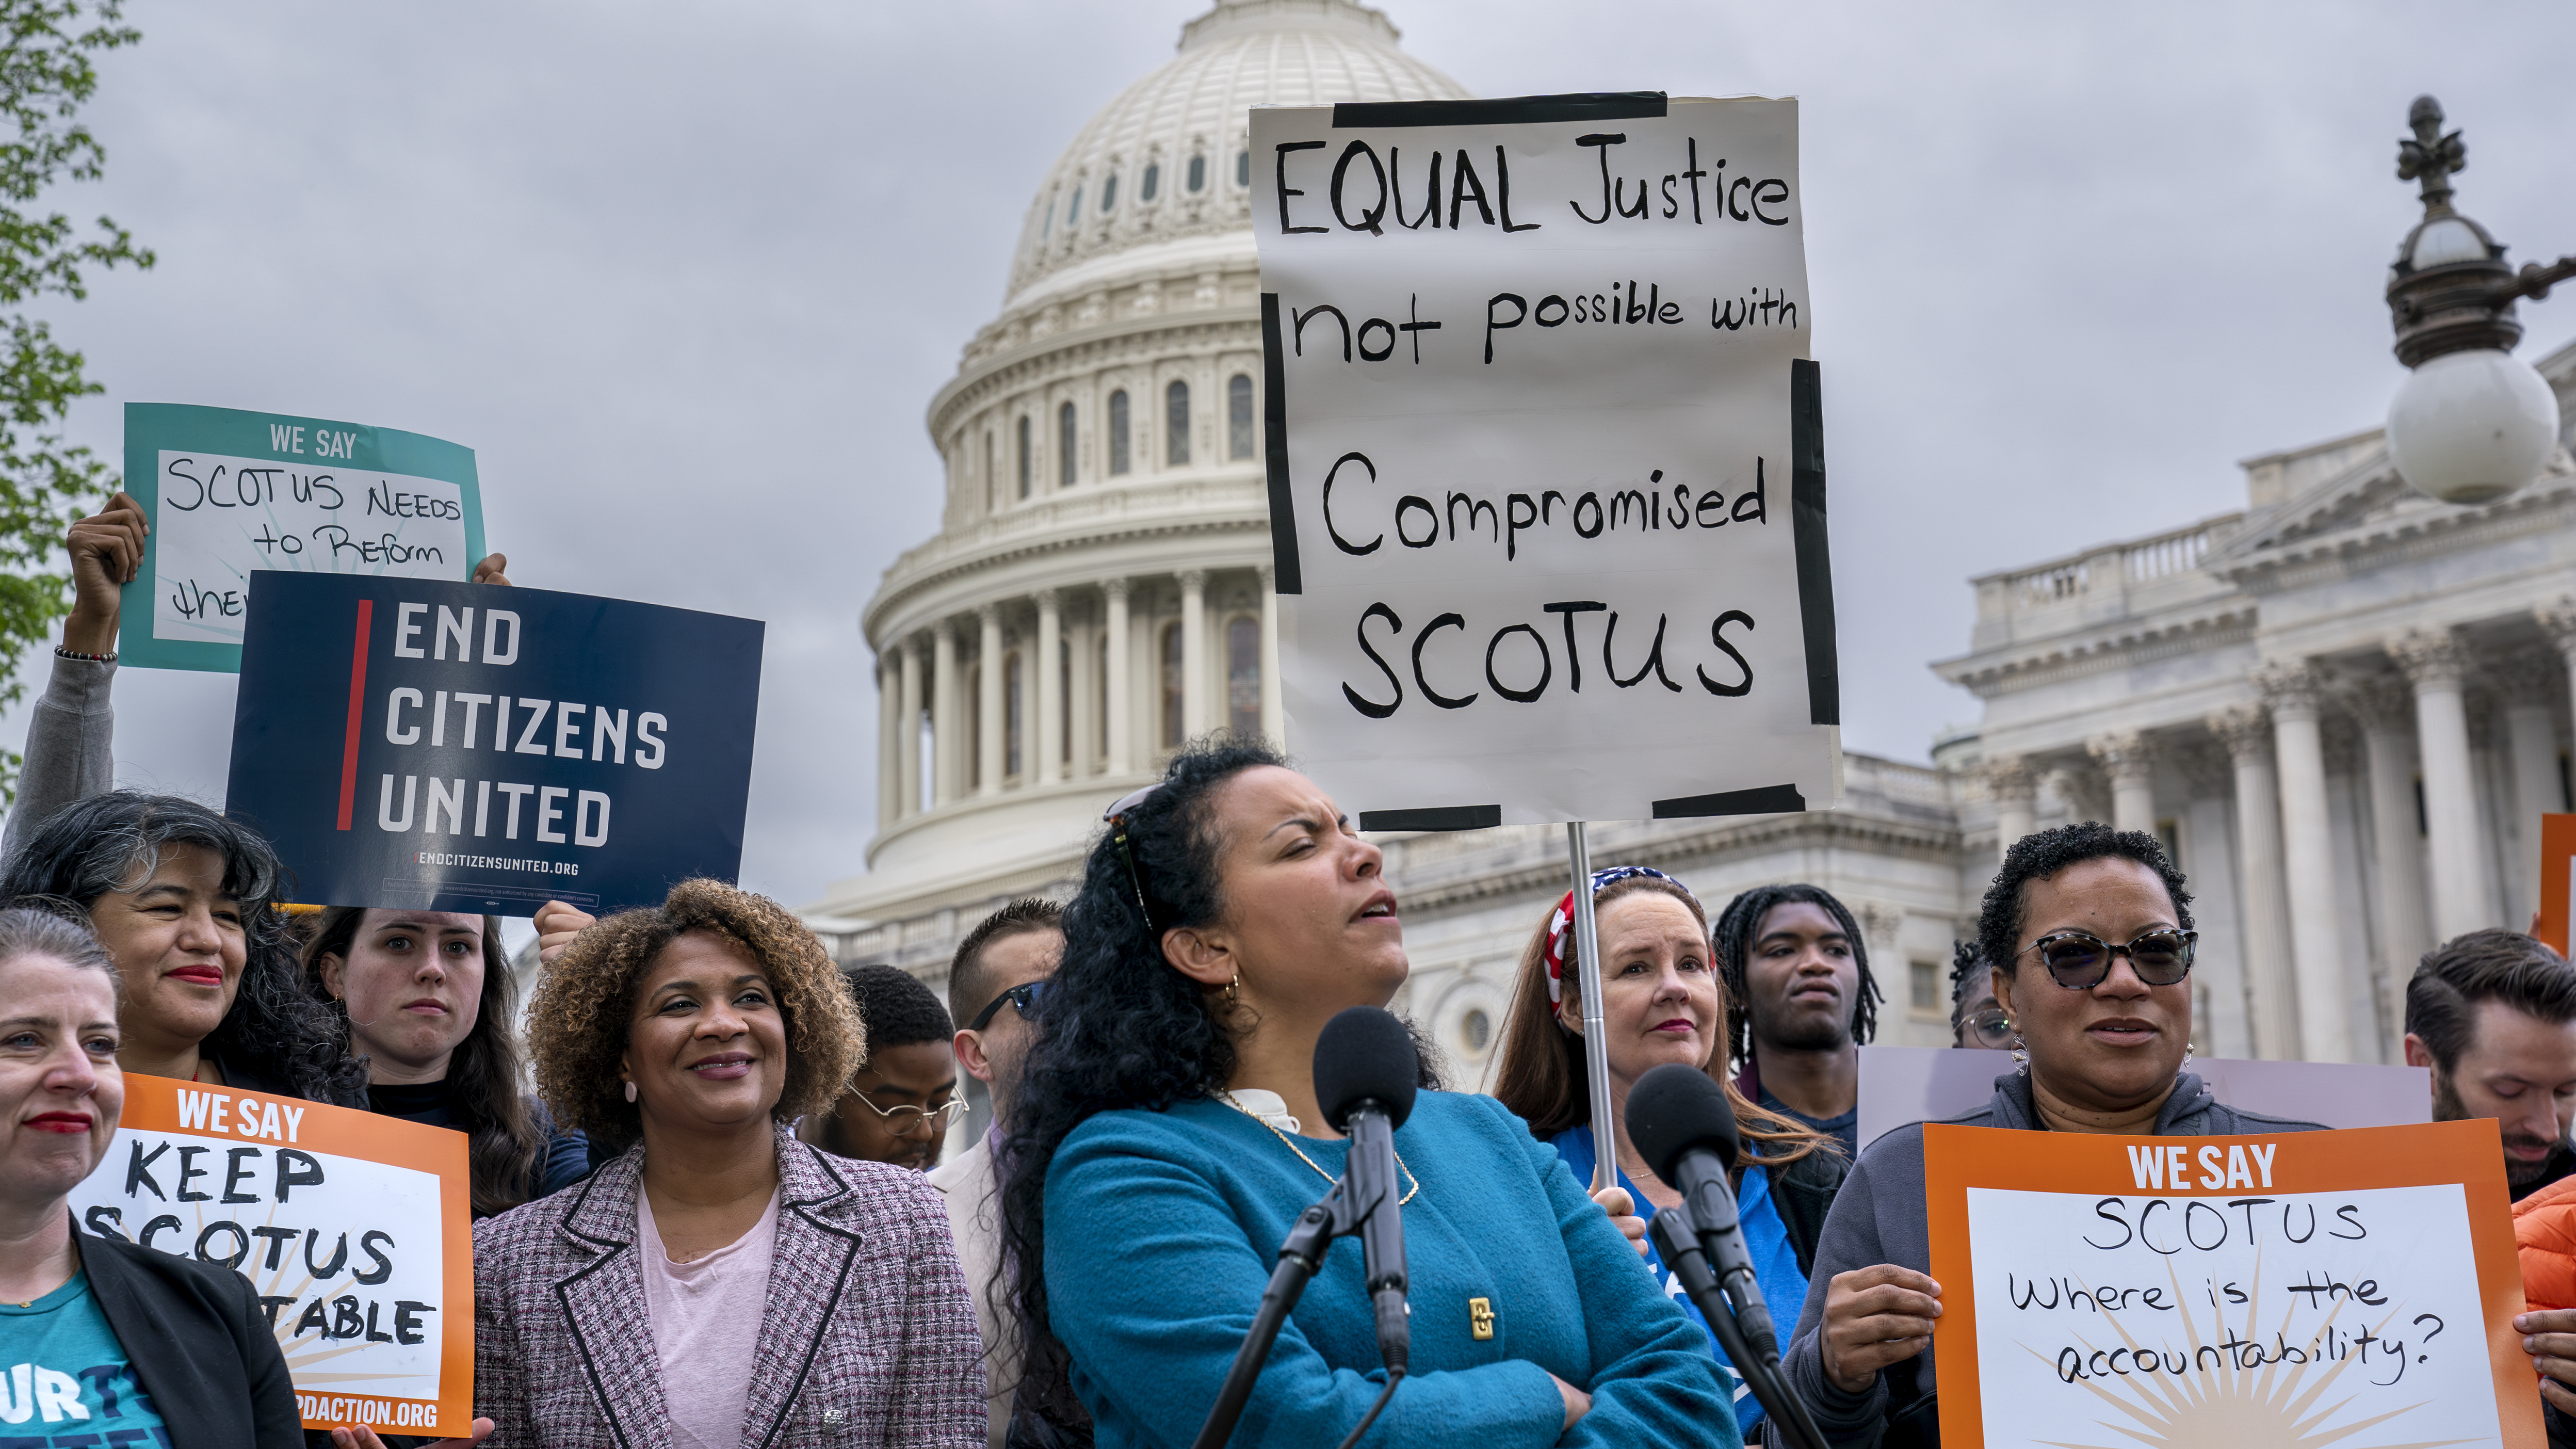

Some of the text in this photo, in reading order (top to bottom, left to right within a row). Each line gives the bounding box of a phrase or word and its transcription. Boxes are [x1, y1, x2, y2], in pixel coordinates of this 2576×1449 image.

[1275, 132, 1789, 237] EQUAL Justice
[1292, 280, 1797, 365] not possible with
[270, 424, 357, 459] WE SAY
[167, 458, 461, 520] SCOTUS NEEDS
[1323, 452, 1767, 562] Compromised
[253, 523, 303, 554] to
[394, 602, 521, 666] END
[1342, 601, 1755, 719] SCOTUS
[386, 687, 668, 769] CITIZENS
[378, 774, 611, 847] UNITED
[419, 852, 579, 876] ENDCITIZENSUNITED.ORG
[177, 1088, 305, 1142] WE SAY
[125, 1139, 325, 1203] KEEP
[2127, 1144, 2277, 1189] WE SAY
[85, 1205, 395, 1285] SCOTUS
[2083, 1197, 2367, 1254] SCOTUS
[2009, 1270, 2389, 1312] Where is the
[2057, 1313, 2444, 1386] accountability?
